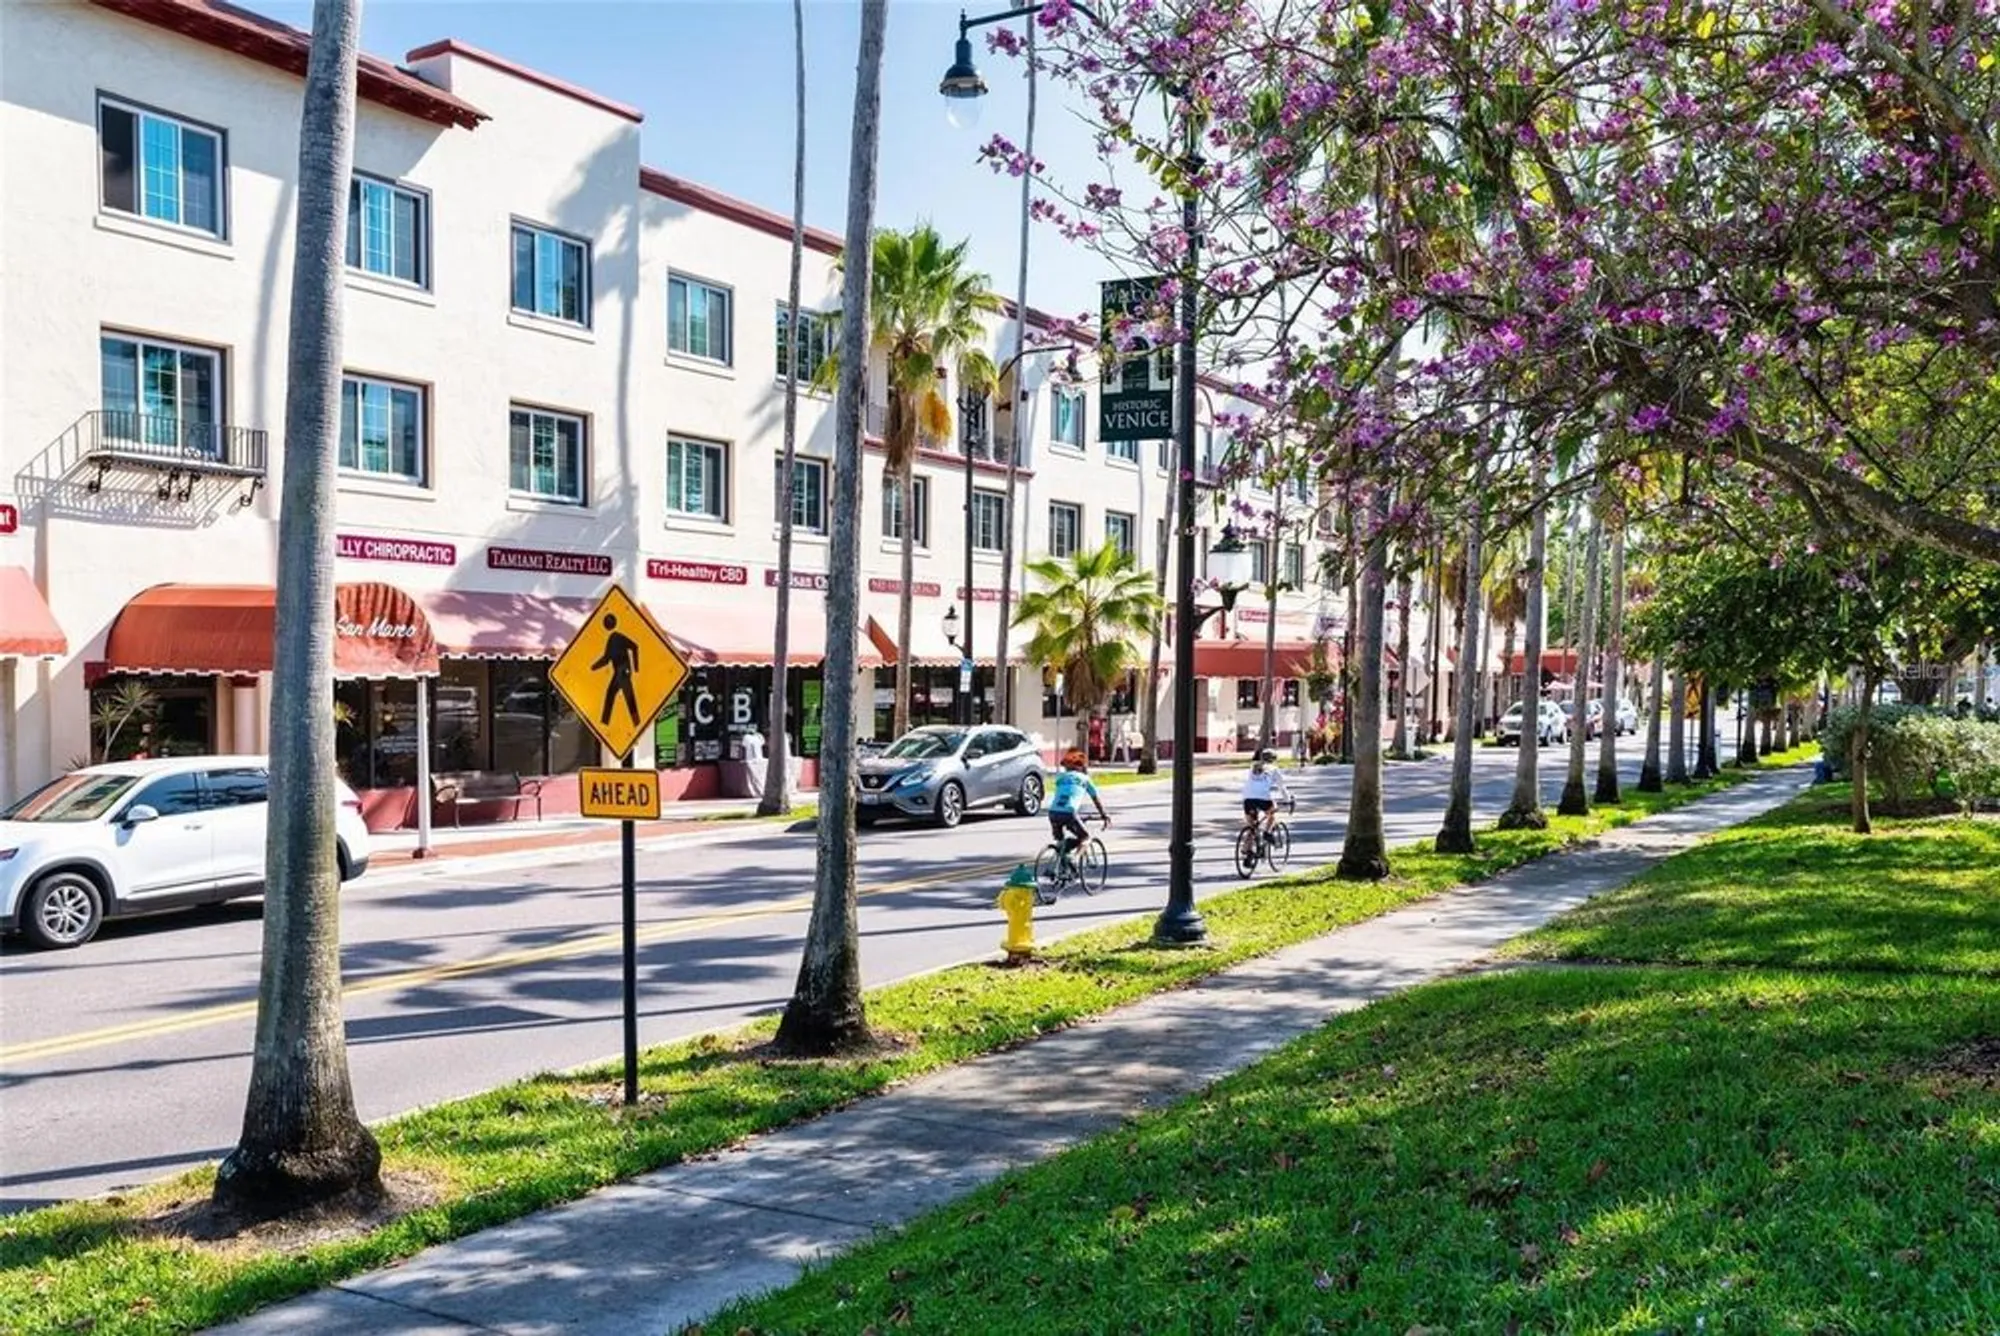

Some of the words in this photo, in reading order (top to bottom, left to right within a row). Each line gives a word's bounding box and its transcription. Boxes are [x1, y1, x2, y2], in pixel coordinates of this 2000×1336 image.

[1112, 399, 1161, 411] HISTORIC
[1104, 410, 1170, 429] VENICE
[363, 541, 453, 563] CHIROPRACTIC
[490, 549, 544, 569] TAMIAMI
[545, 554, 586, 572] REALTY
[586, 556, 609, 573] LLC
[650, 562, 718, 581] Tri-Healthy
[719, 567, 744, 582] CBD
[590, 781, 650, 807] AHEAD
